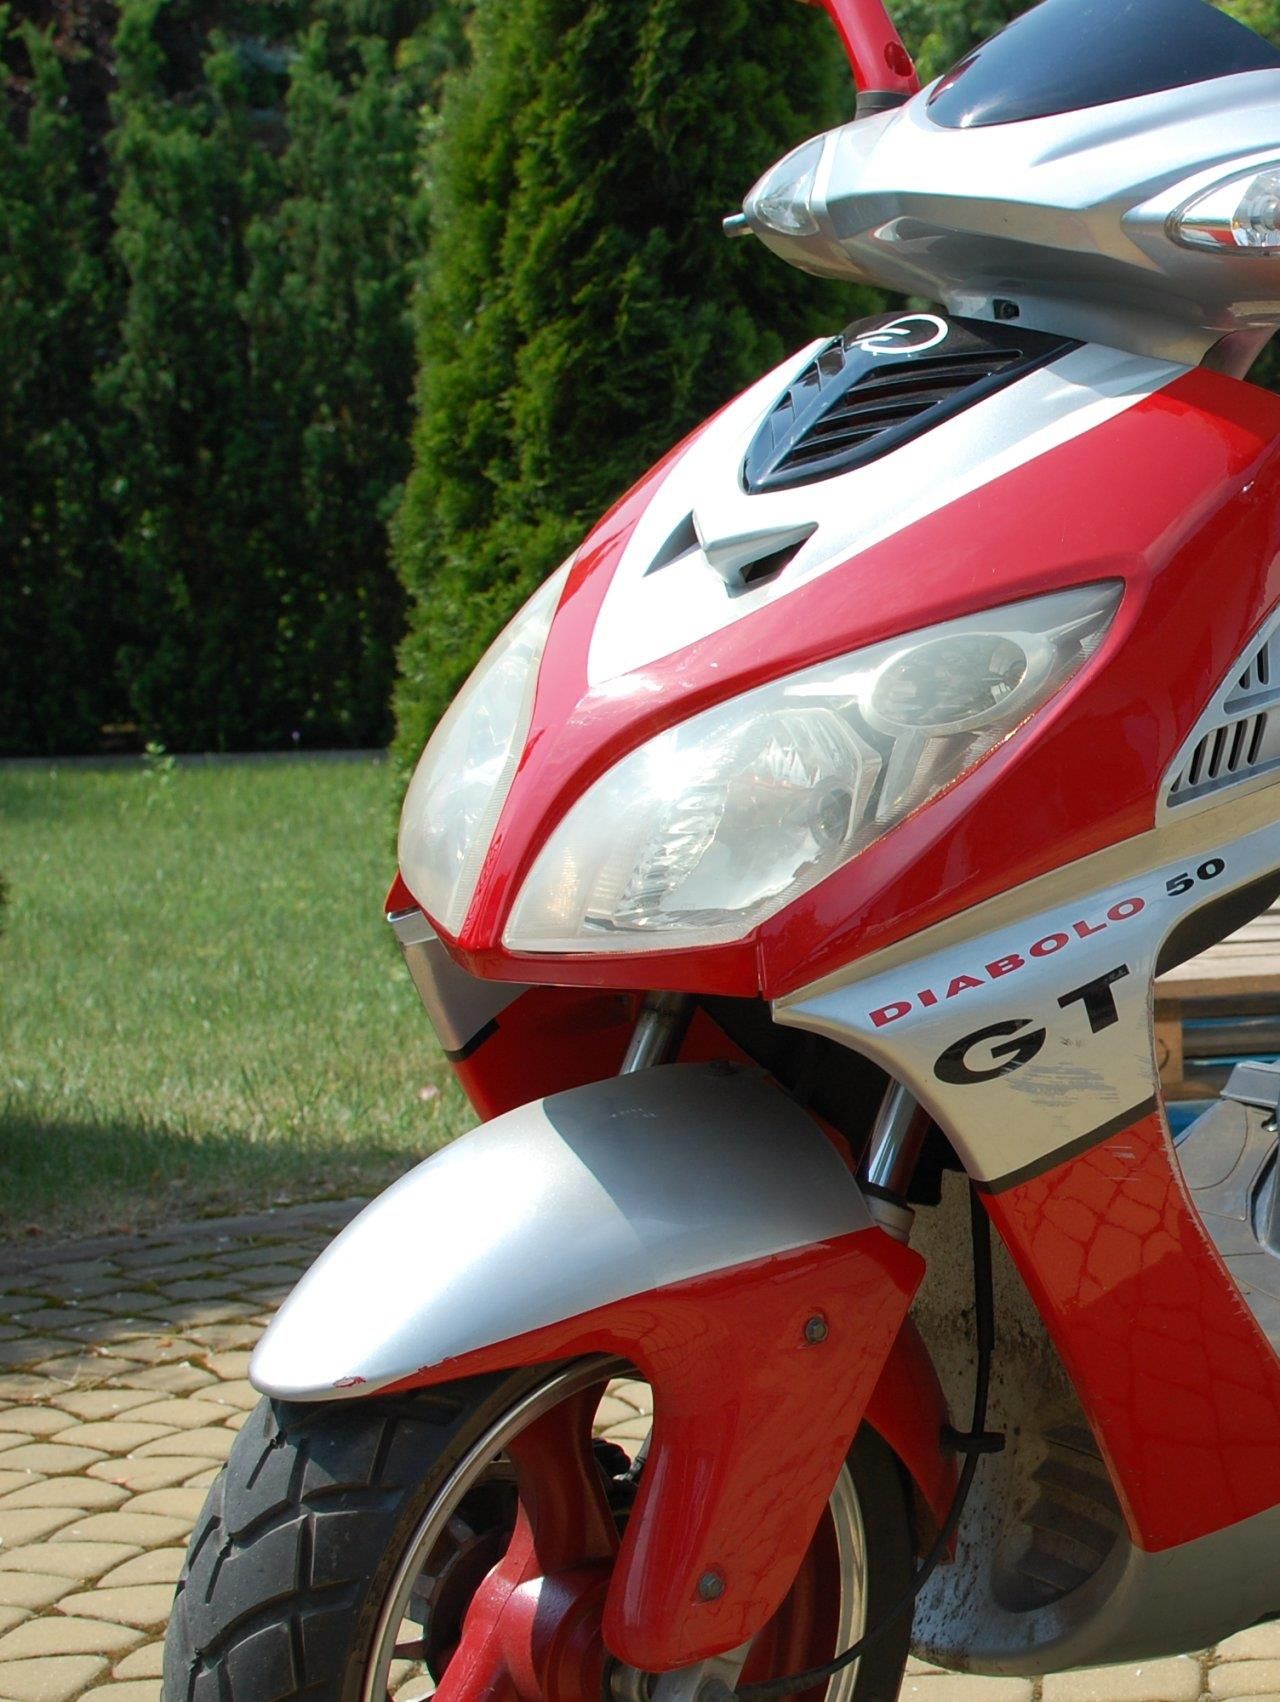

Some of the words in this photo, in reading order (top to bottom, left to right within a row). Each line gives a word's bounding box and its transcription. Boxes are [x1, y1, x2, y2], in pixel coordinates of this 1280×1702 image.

[868, 896, 1146, 1028] DIABOLO
[1165, 857, 1226, 897] 50
[933, 964, 1131, 1085] GT
